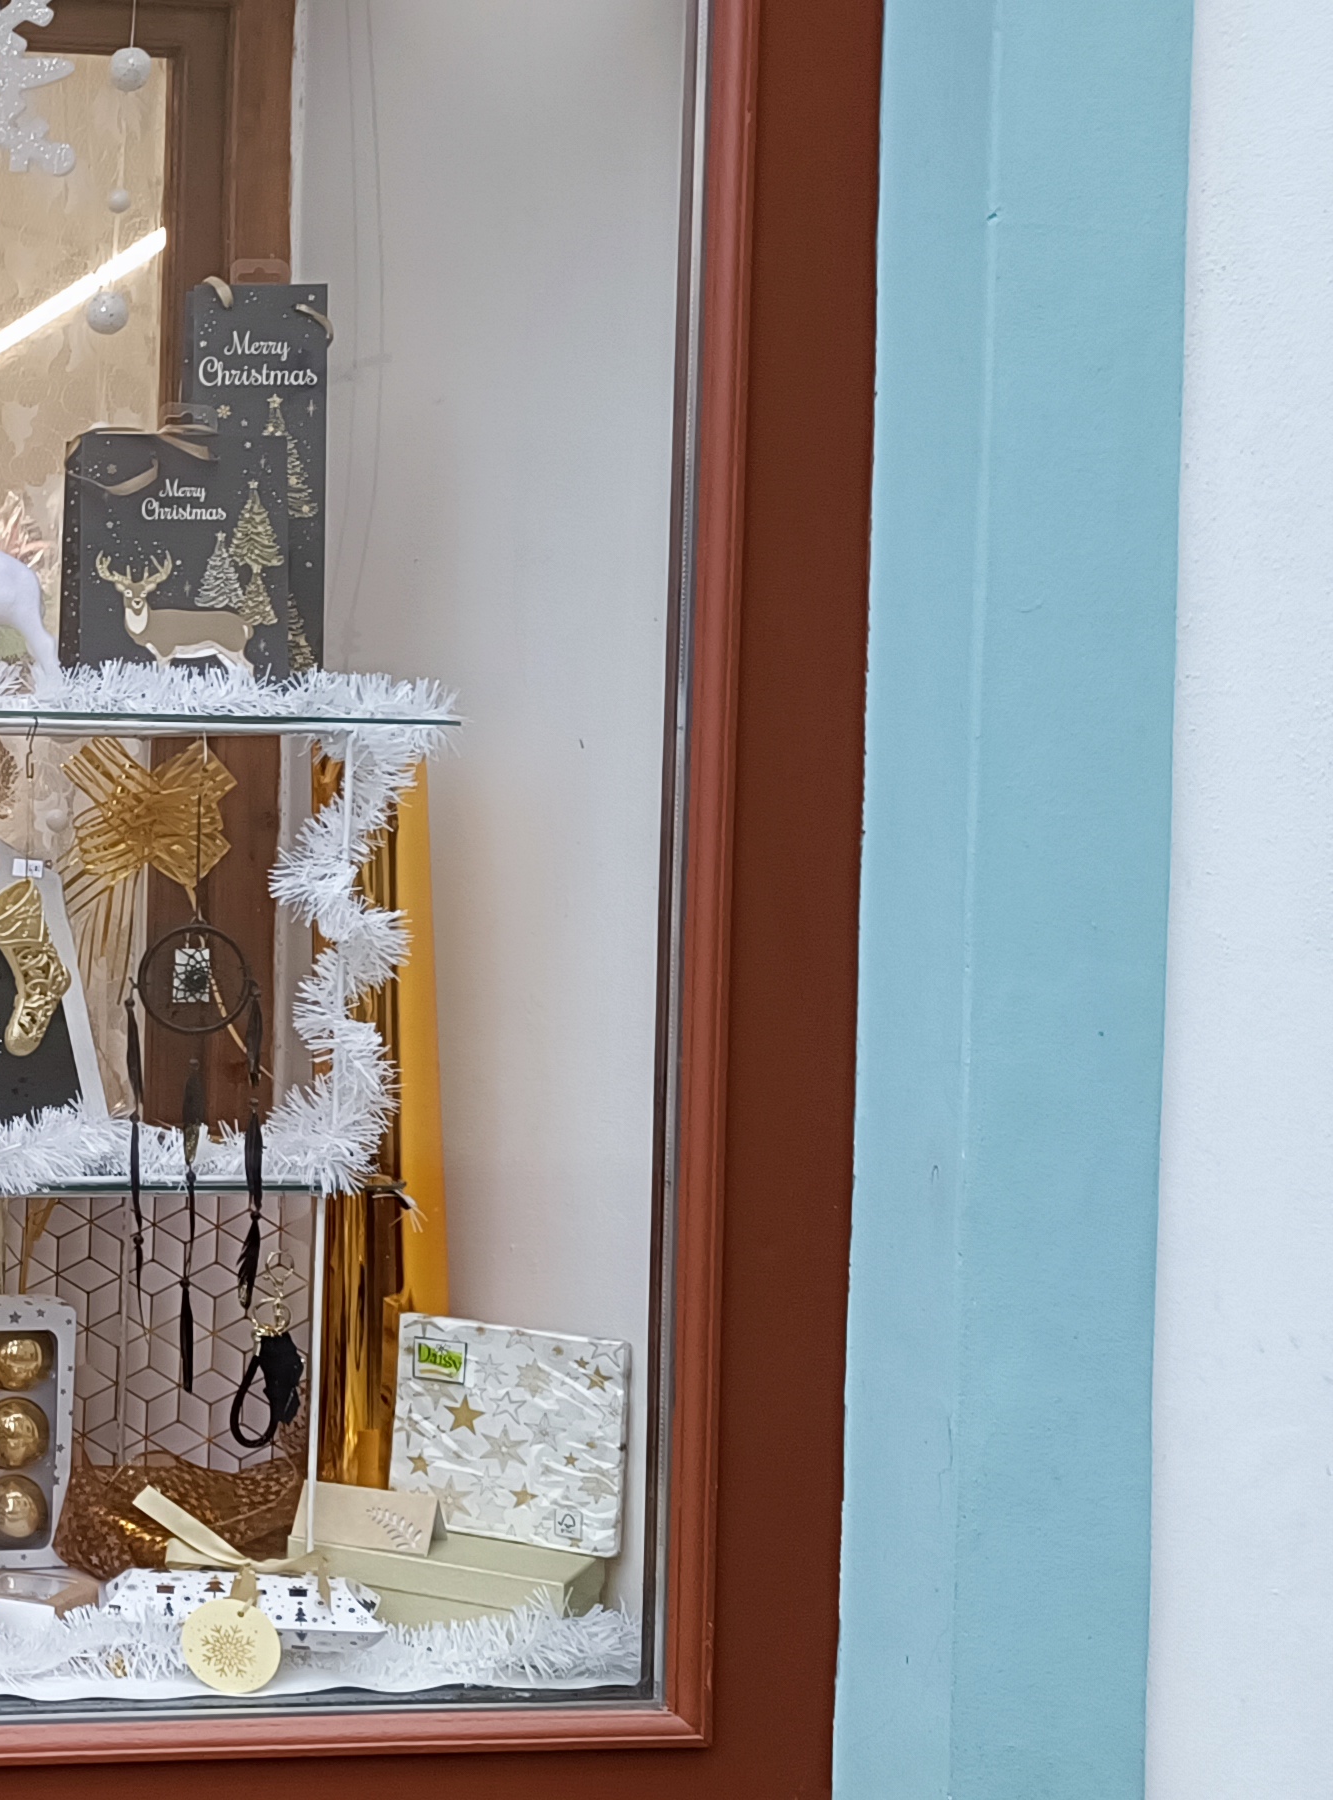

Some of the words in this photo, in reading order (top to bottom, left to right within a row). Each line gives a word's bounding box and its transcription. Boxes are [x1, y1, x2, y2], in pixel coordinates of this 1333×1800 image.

[223, 329, 291, 361] Merry
[198, 356, 318, 387] Christmas
[159, 478, 206, 502] Merry
[141, 497, 227, 521] Christmas
[418, 1343, 463, 1374] Daisy
